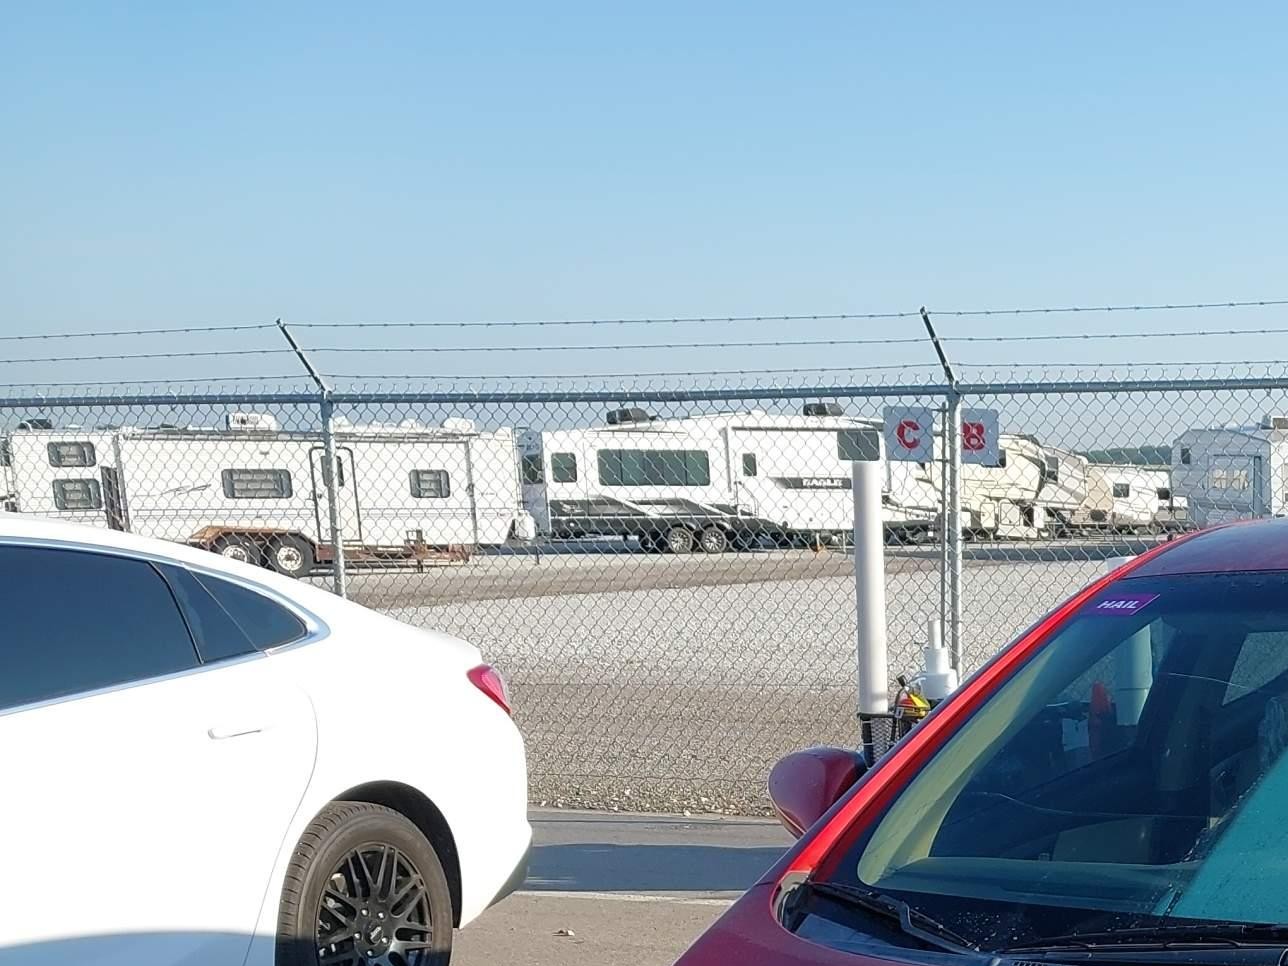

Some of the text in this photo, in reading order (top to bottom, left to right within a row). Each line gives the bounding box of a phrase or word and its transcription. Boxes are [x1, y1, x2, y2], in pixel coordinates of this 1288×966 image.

[896, 420, 921, 449] C
[963, 421, 986, 450] B
[1096, 600, 1140, 609] HAIL
